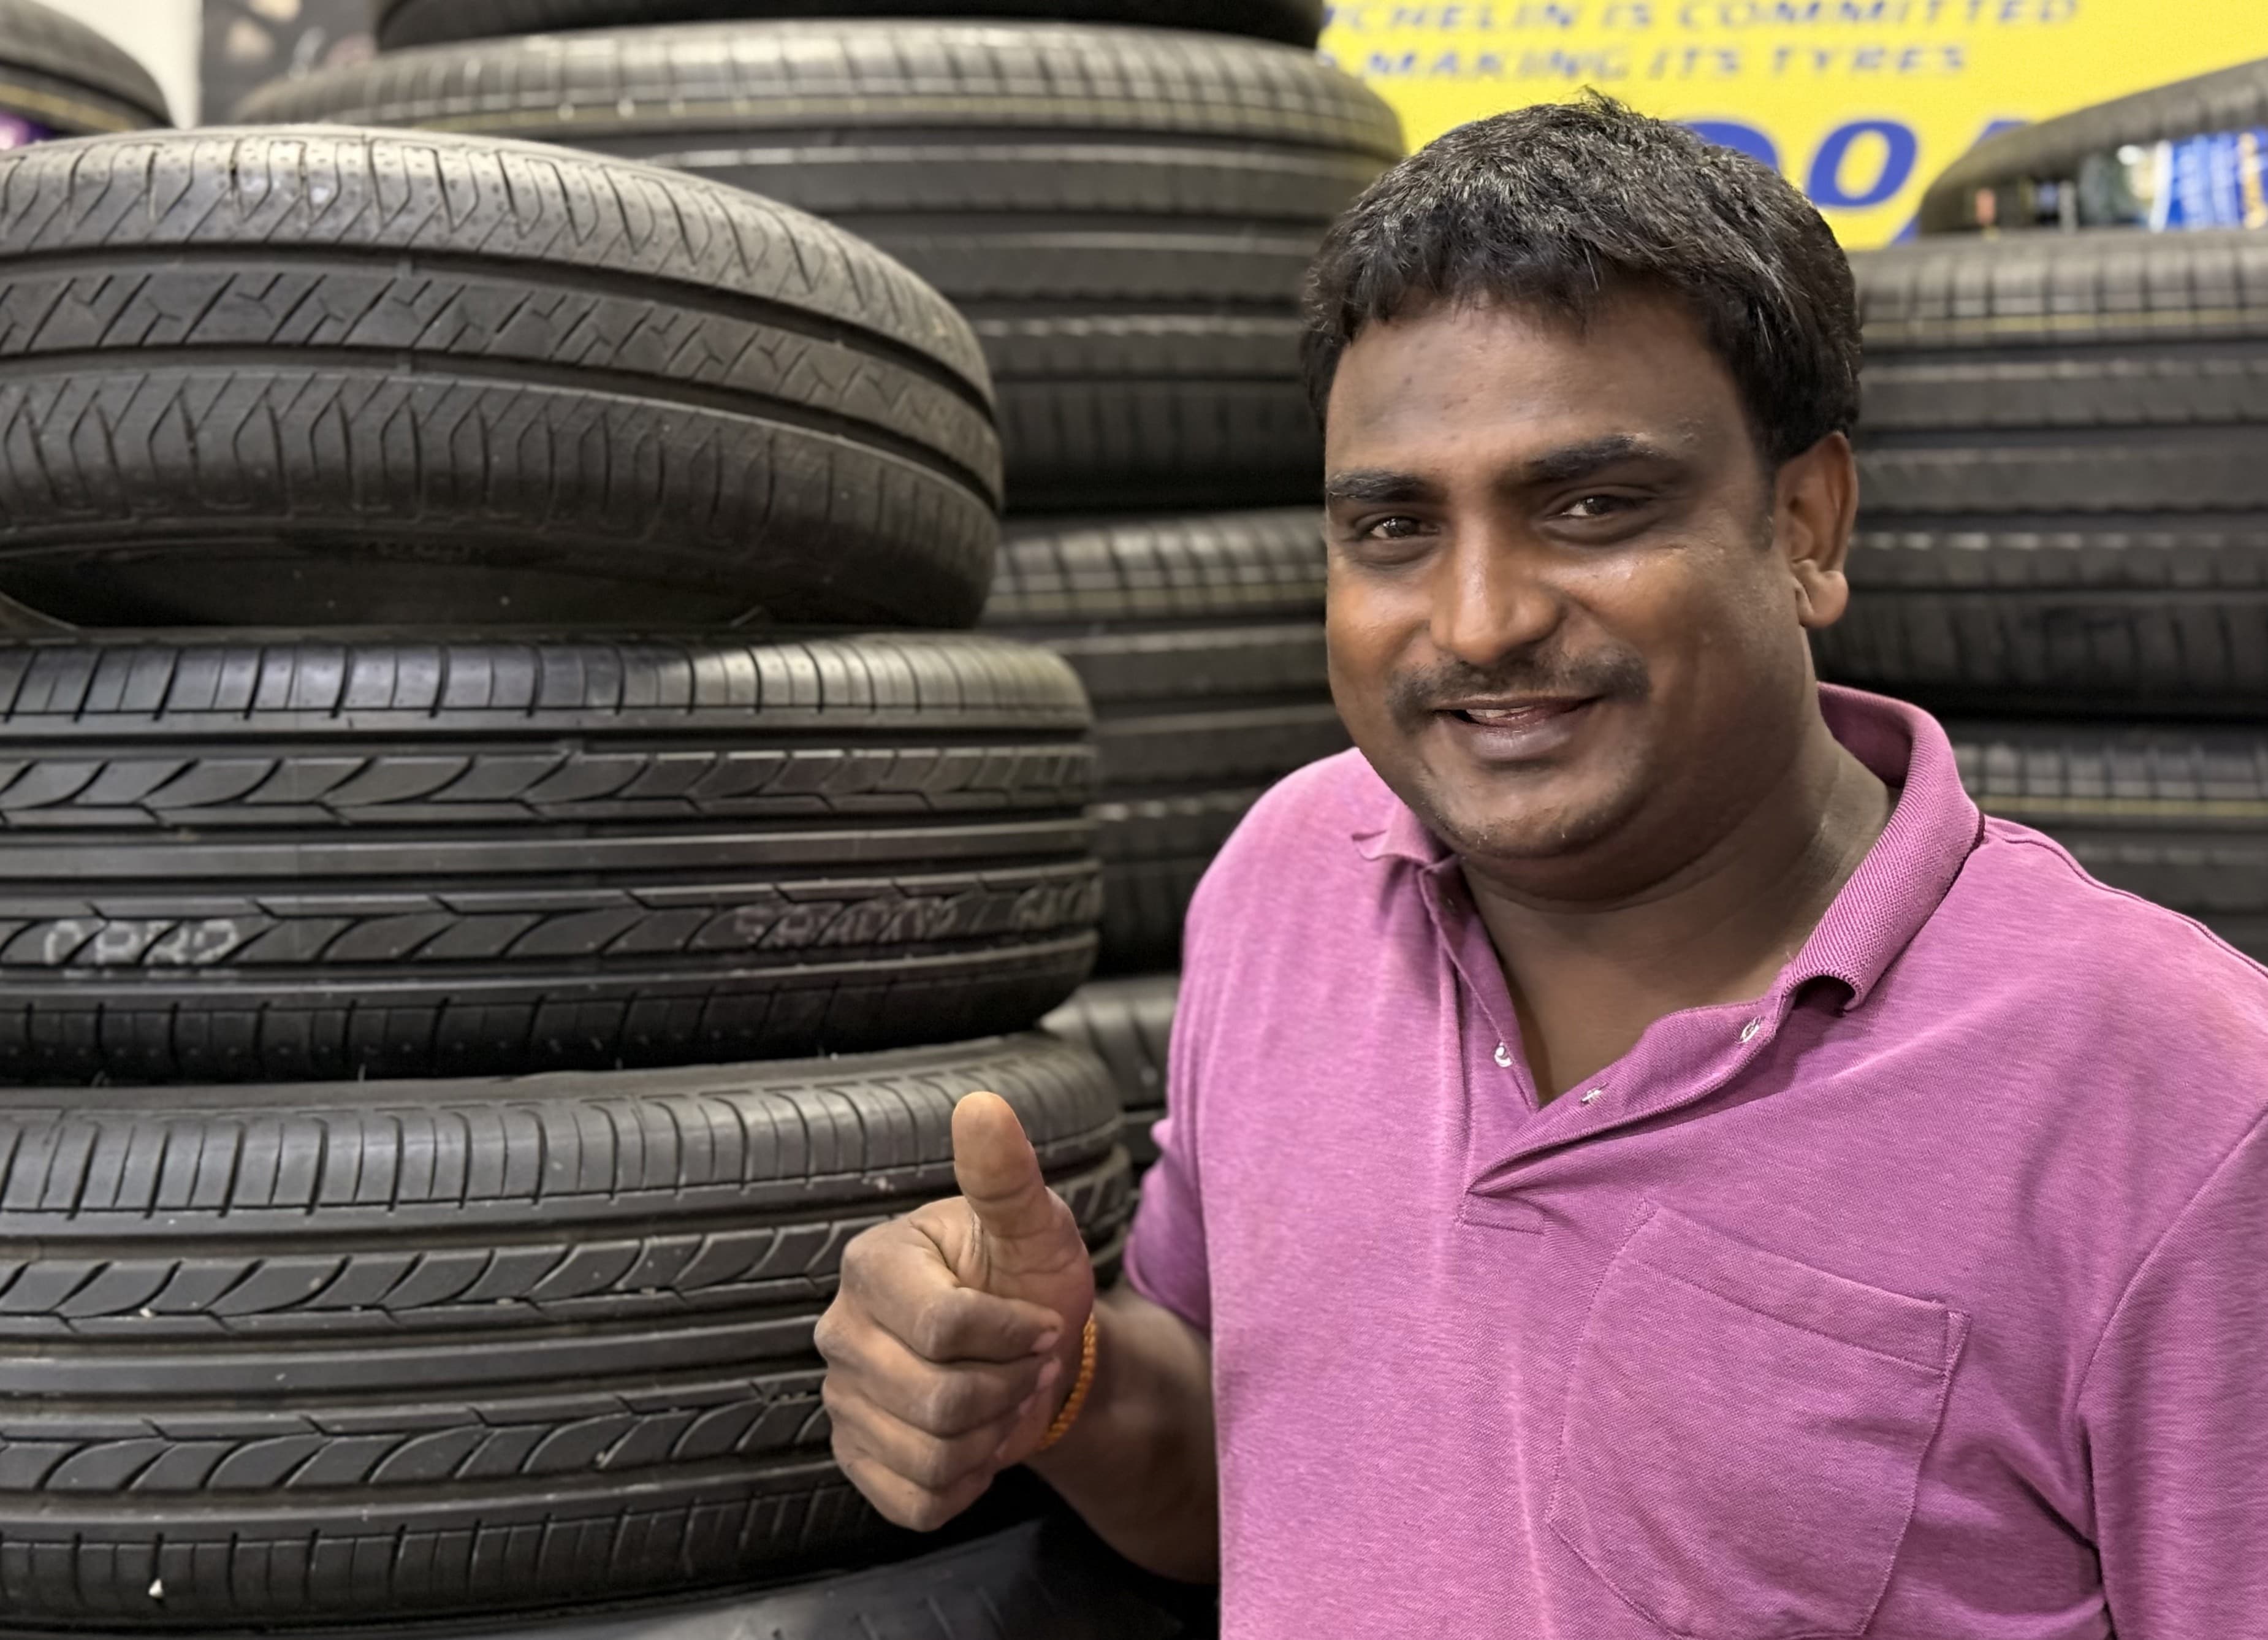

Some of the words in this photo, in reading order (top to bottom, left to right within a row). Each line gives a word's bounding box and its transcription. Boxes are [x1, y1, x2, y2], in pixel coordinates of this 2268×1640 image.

[1602, 2, 1651, 28] IS
[1678, 0, 2078, 28] COMMITTED
[1367, 50, 1628, 78] MAKING
[1649, 47, 1741, 77] ITS
[1773, 45, 1966, 74] TYRES
